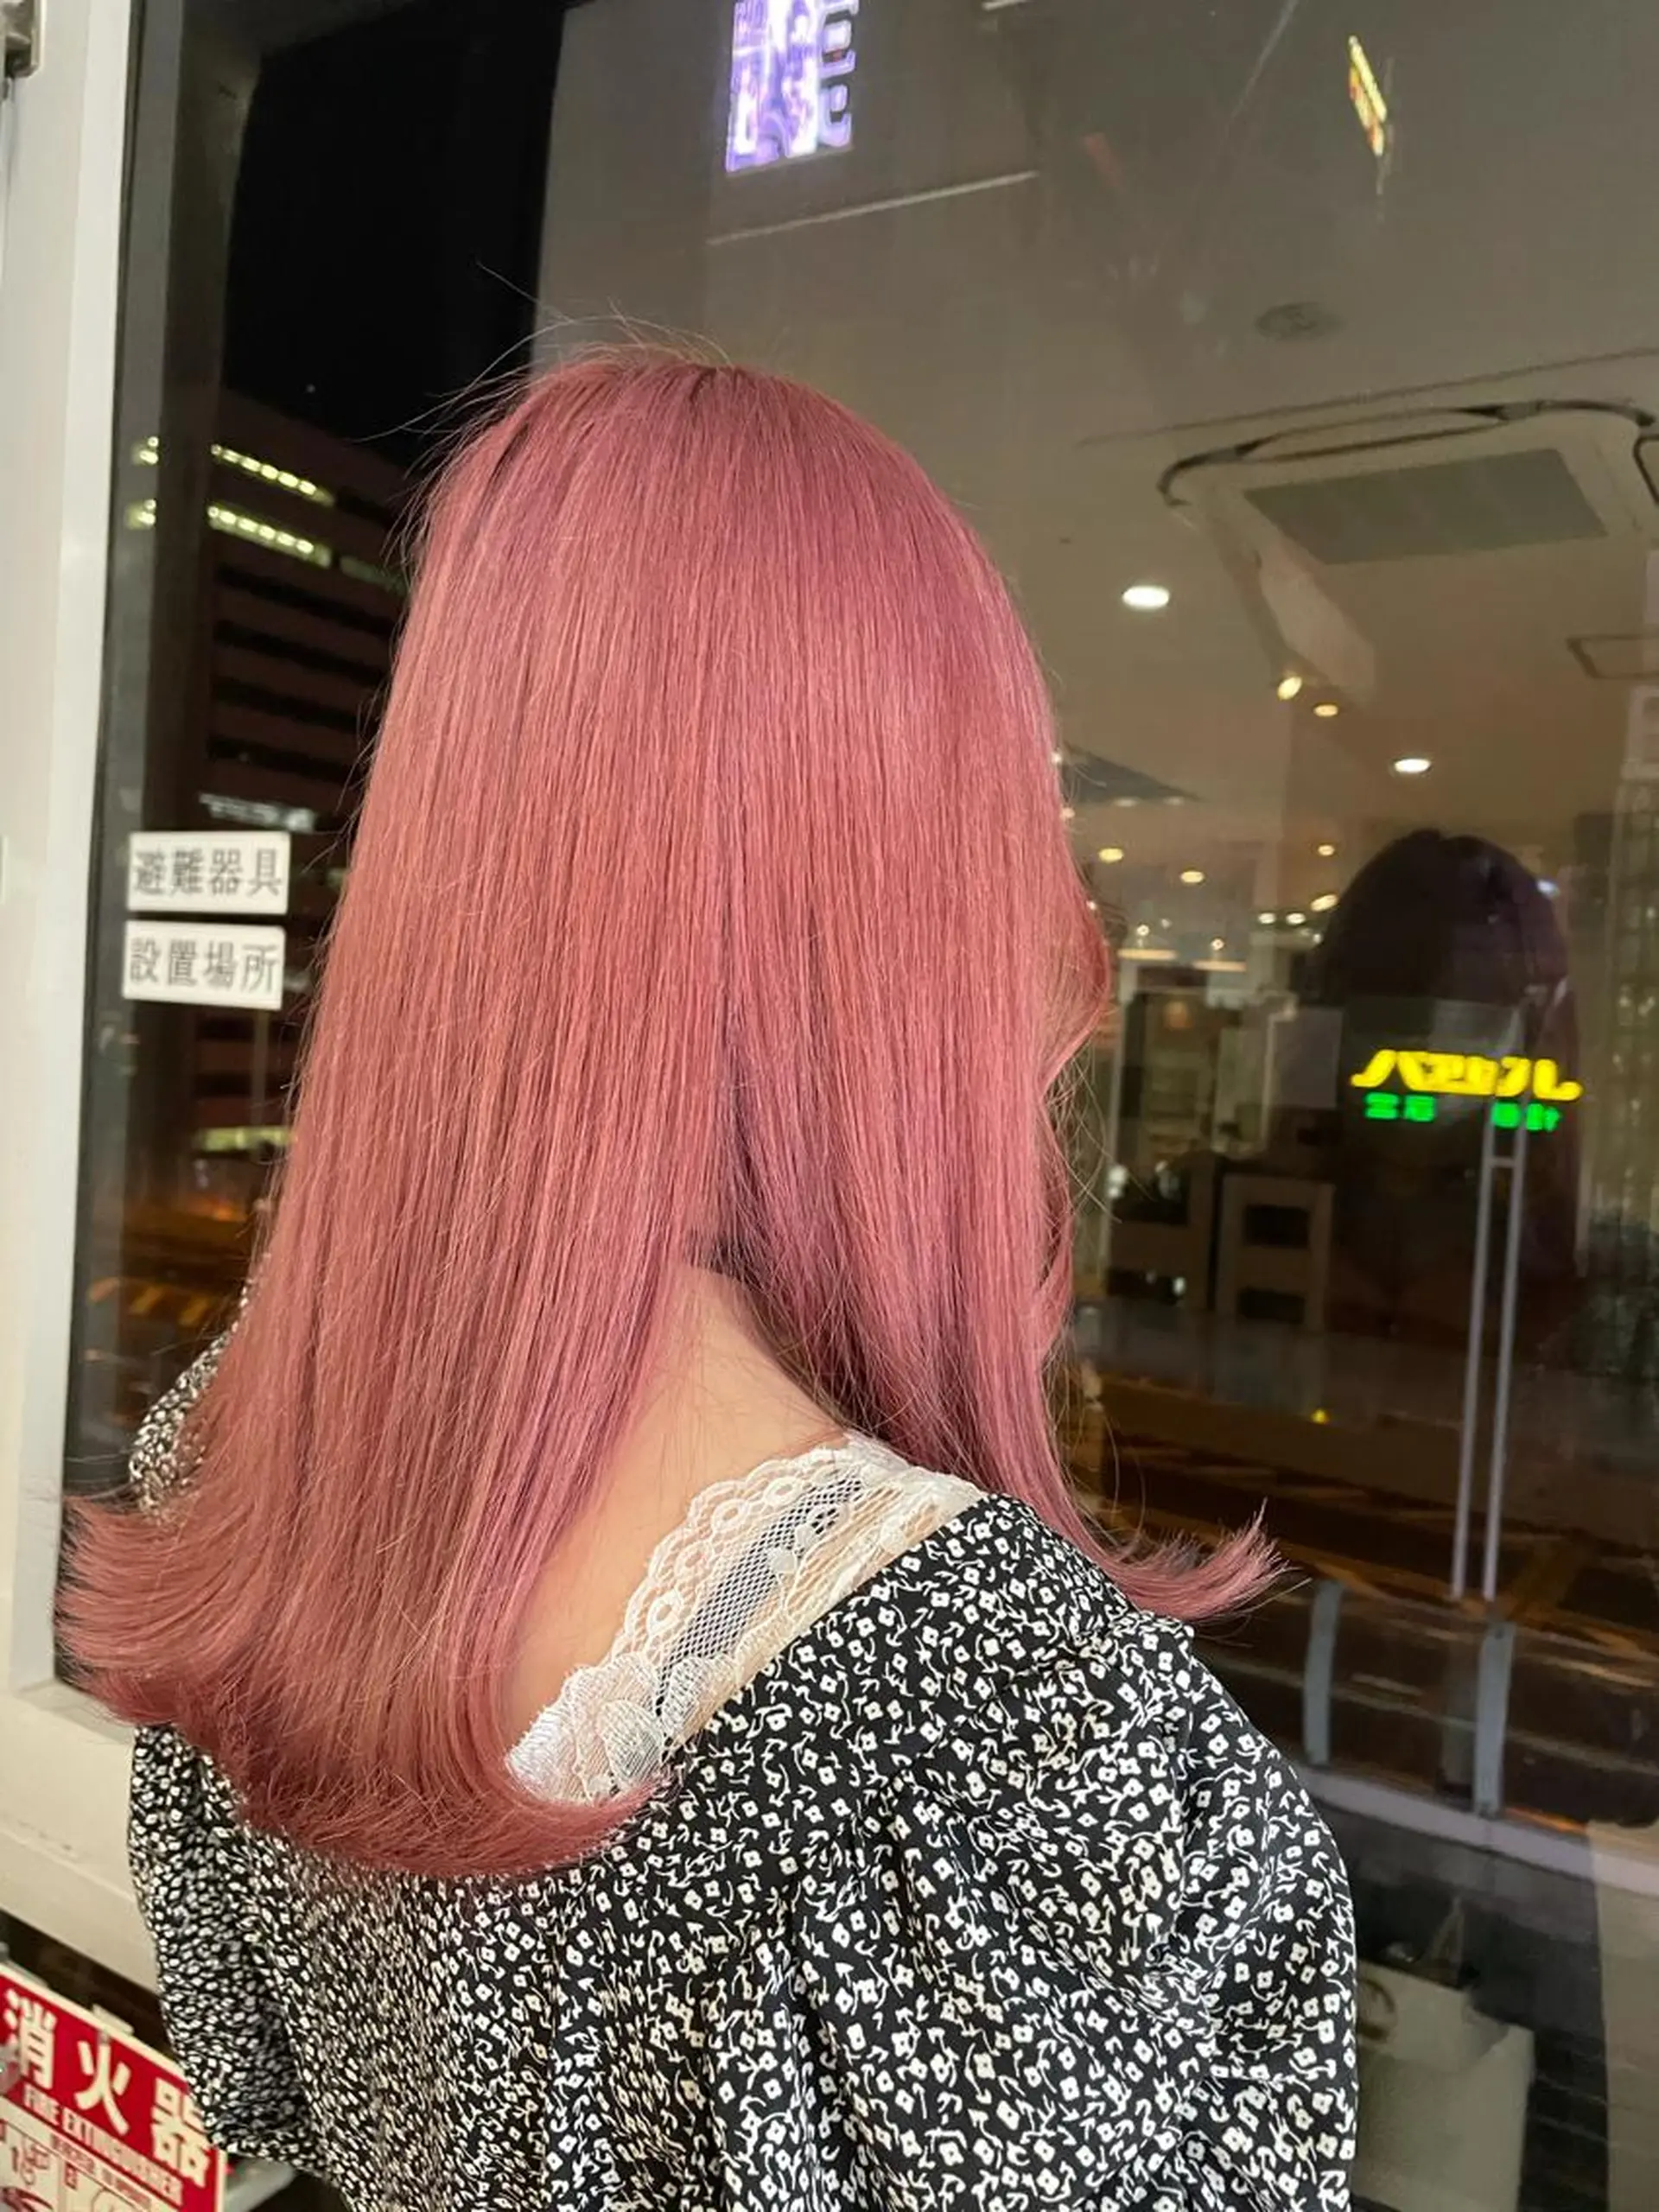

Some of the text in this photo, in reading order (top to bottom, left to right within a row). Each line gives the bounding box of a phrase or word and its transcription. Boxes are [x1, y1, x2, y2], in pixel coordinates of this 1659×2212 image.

[134, 848, 282, 897] 避難器具
[130, 937, 278, 993] 設置場所
[3, 1988, 213, 2188] 消火器
